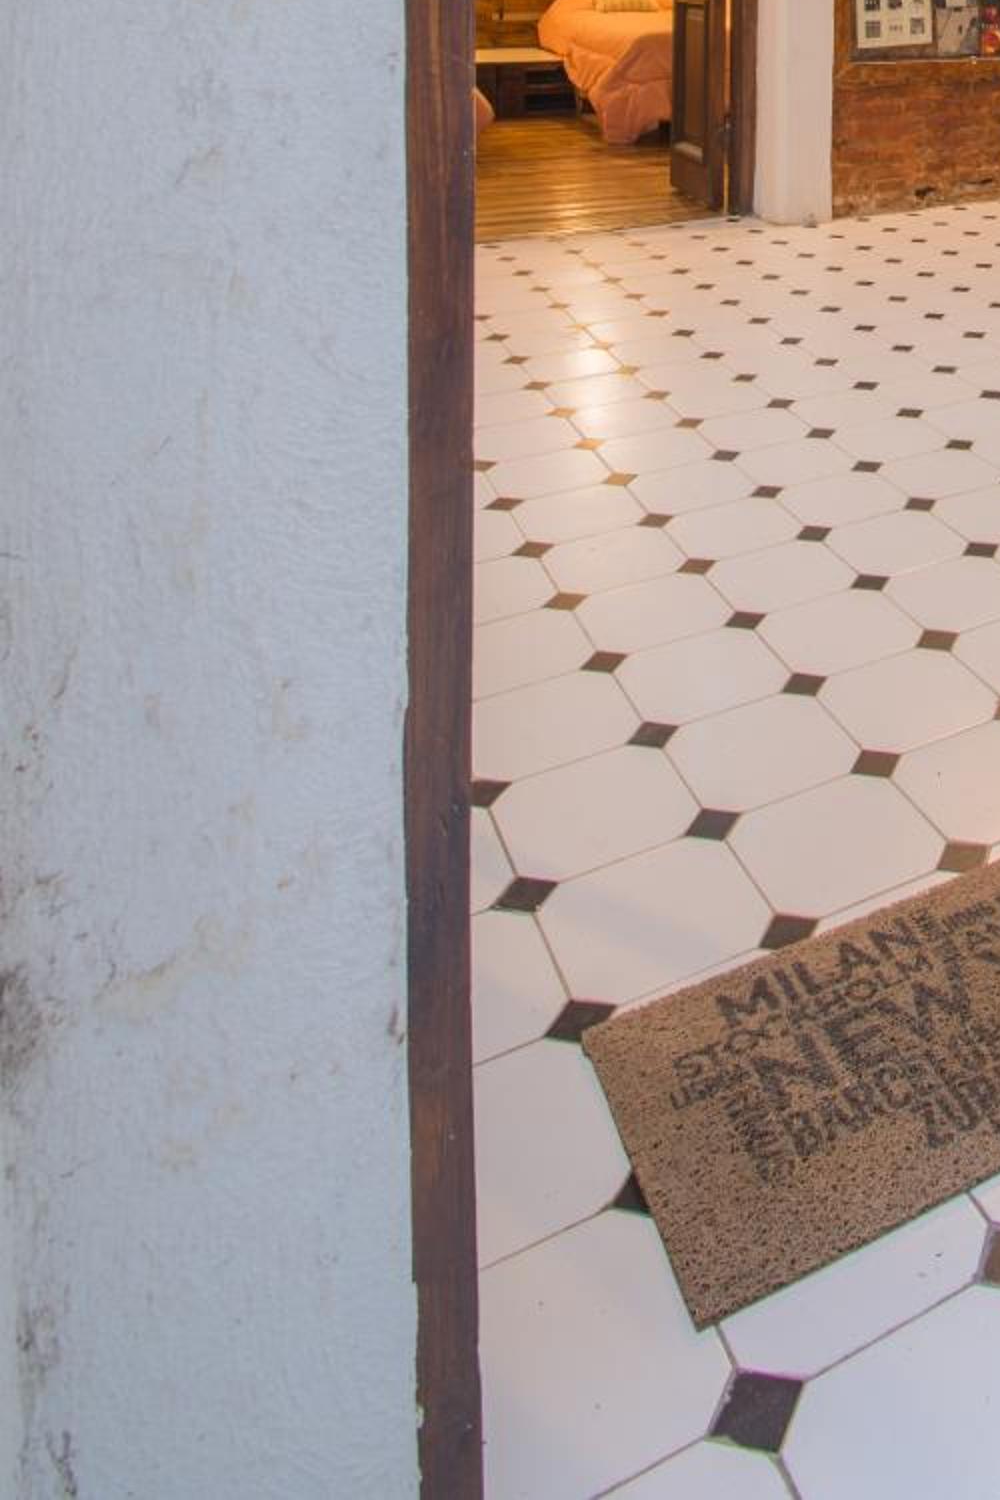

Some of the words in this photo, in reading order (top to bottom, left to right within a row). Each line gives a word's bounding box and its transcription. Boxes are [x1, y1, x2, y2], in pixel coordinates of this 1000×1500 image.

[673, 952, 932, 1080] STOCKHOLM
[714, 916, 918, 1029] MILAN
[751, 964, 974, 1111] NEW
